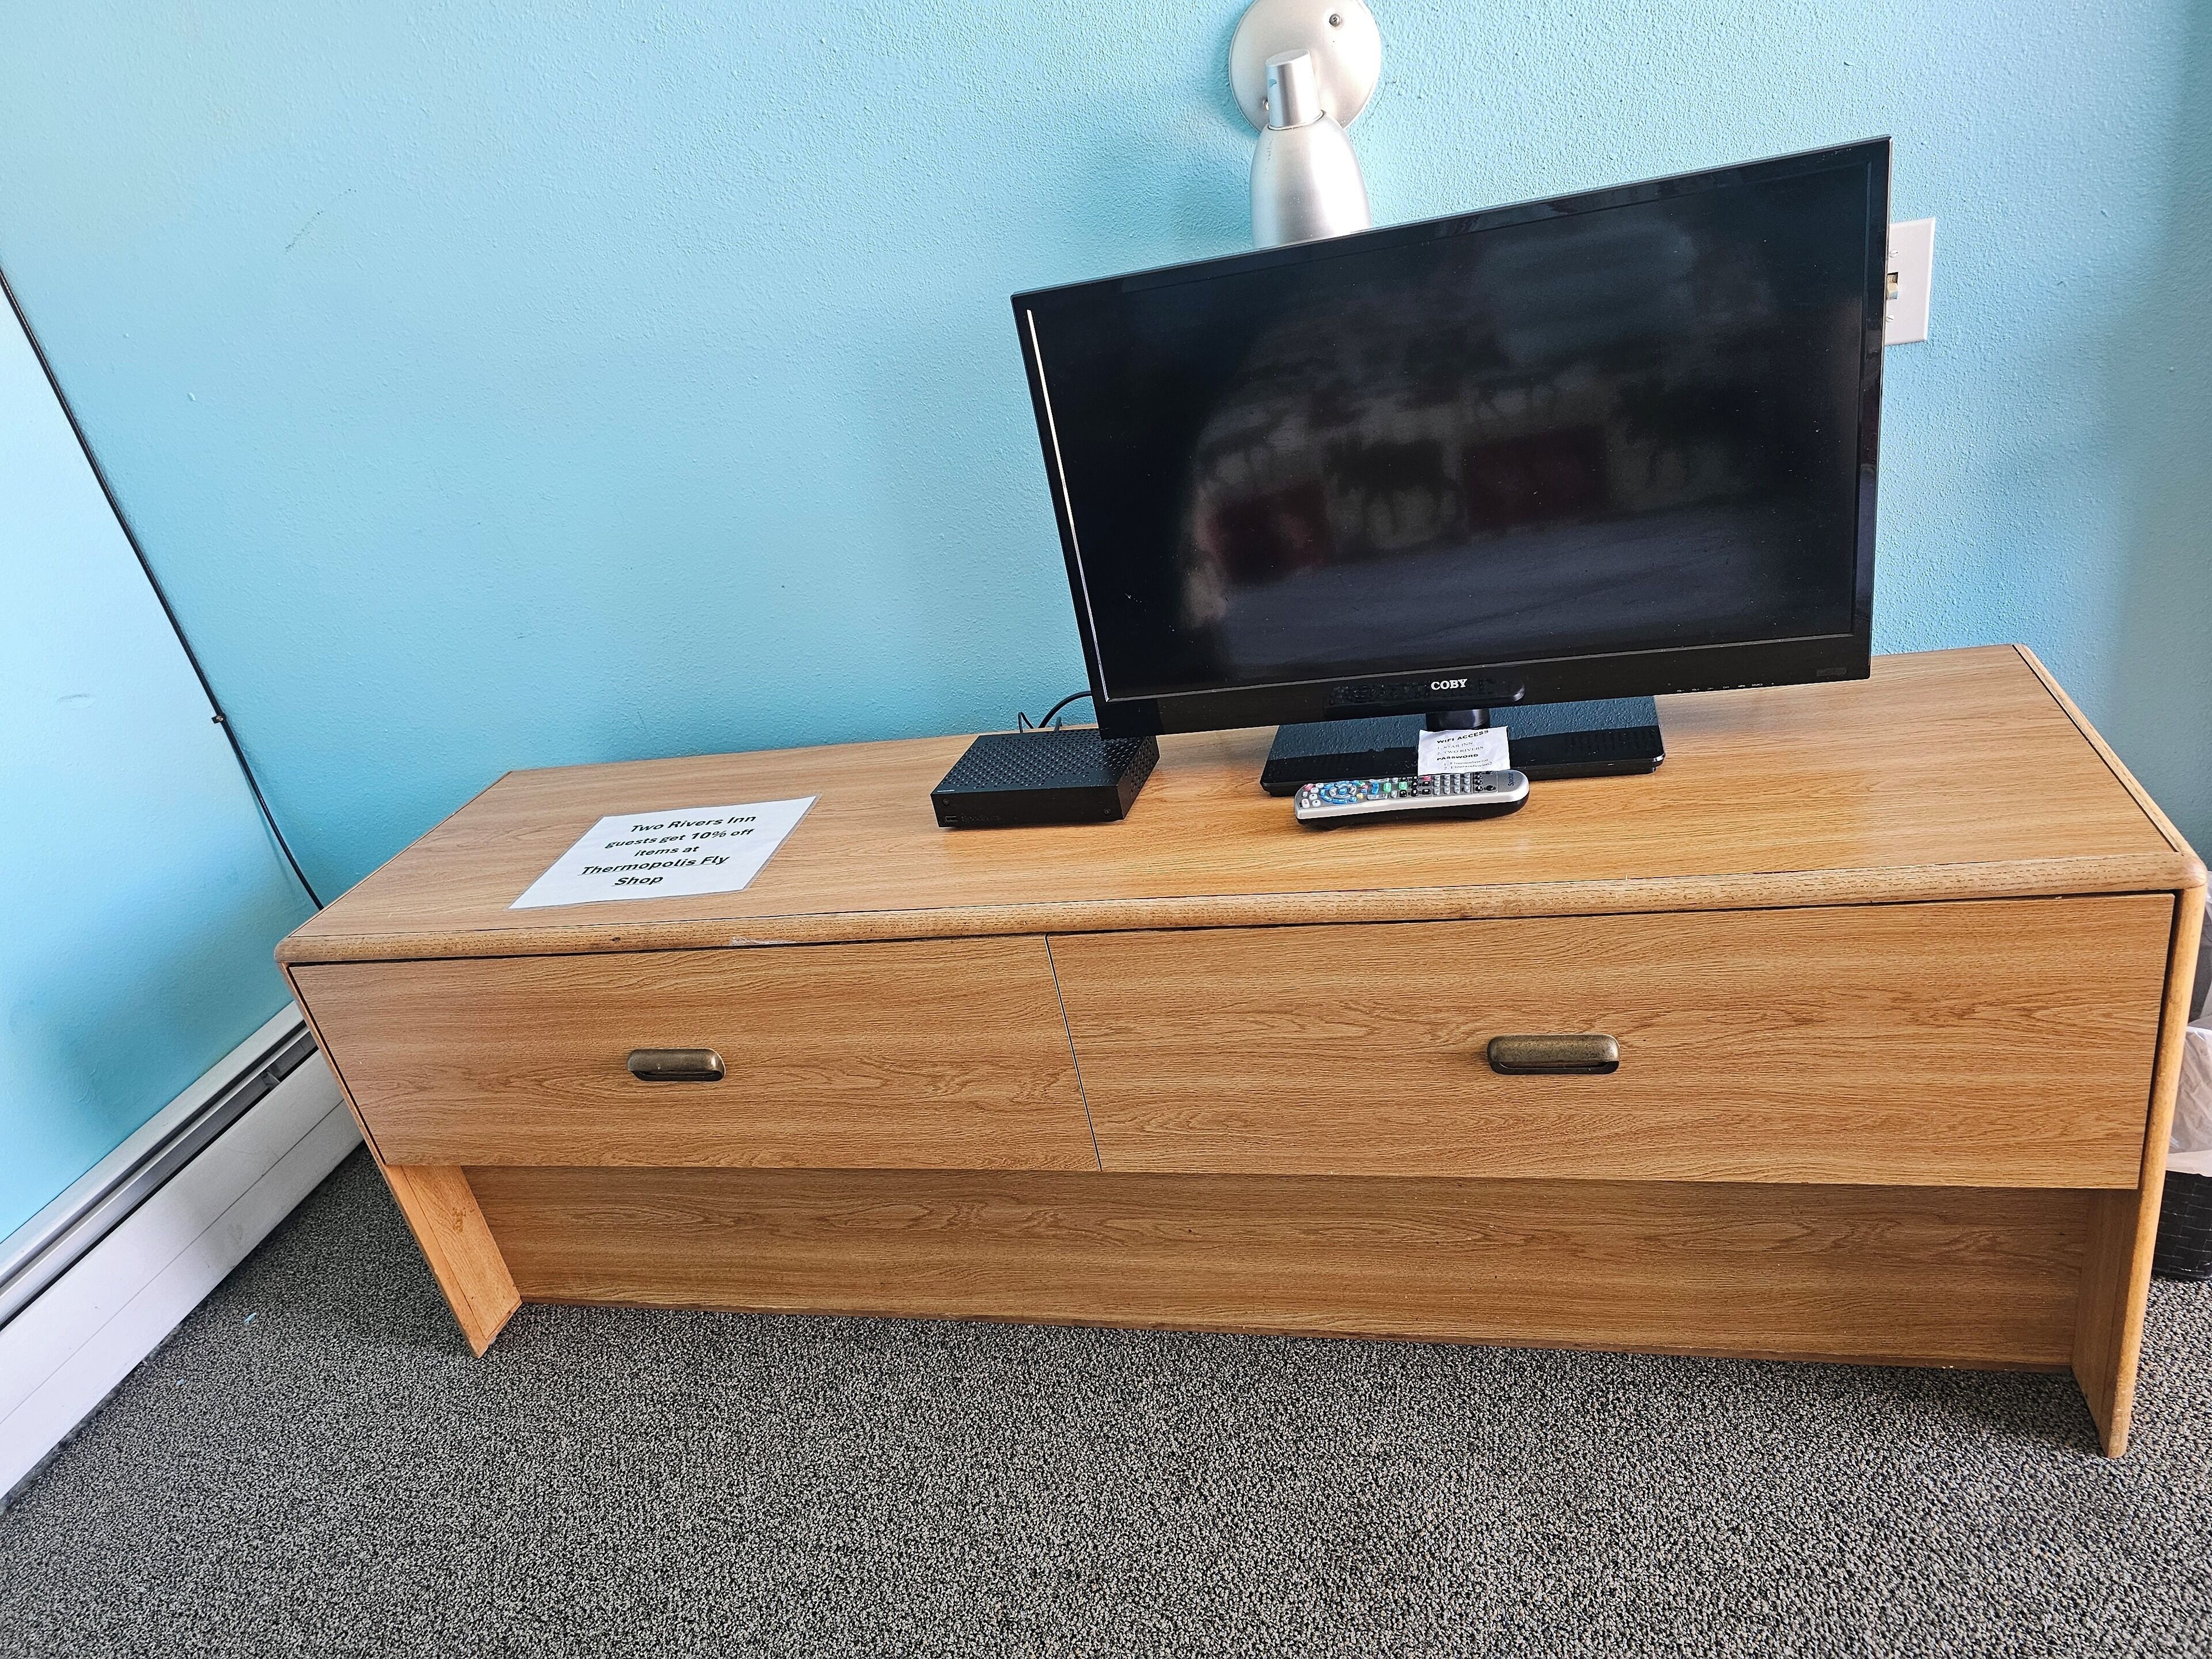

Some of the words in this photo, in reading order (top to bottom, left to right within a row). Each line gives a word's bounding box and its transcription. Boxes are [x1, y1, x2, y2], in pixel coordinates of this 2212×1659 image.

[1431, 679, 1468, 690] COBY
[1457, 730, 1489, 740] ACCESS
[631, 824, 664, 832] Two
[667, 819, 724, 828] Rivers
[727, 816, 756, 824] Inn
[604, 838, 658, 849] guests
[658, 835, 686, 843] get
[691, 830, 727, 839] 10%
[634, 848, 680, 857] items
[581, 858, 697, 875] Thermopolis
[700, 855, 730, 865] Fly
[614, 876, 664, 885] Shop
